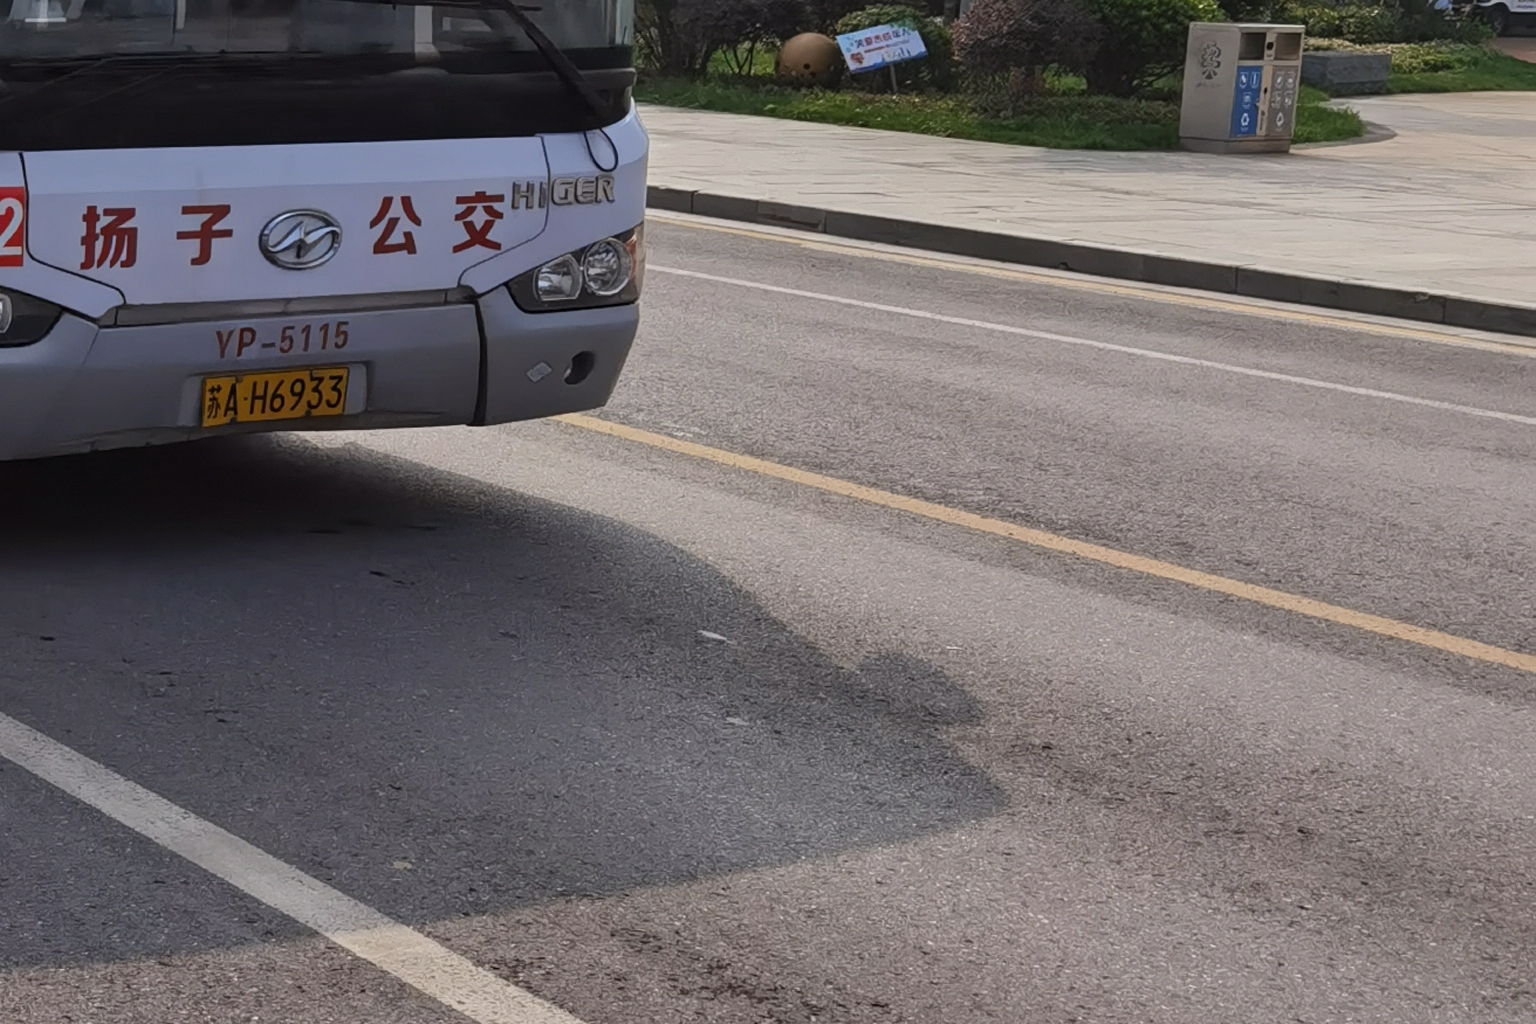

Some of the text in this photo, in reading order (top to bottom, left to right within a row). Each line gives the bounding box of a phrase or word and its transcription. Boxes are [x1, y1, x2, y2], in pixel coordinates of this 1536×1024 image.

[511, 176, 615, 210] HIGER
[80, 191, 505, 269] 扬子 公交
[216, 321, 349, 359] YP-5115
